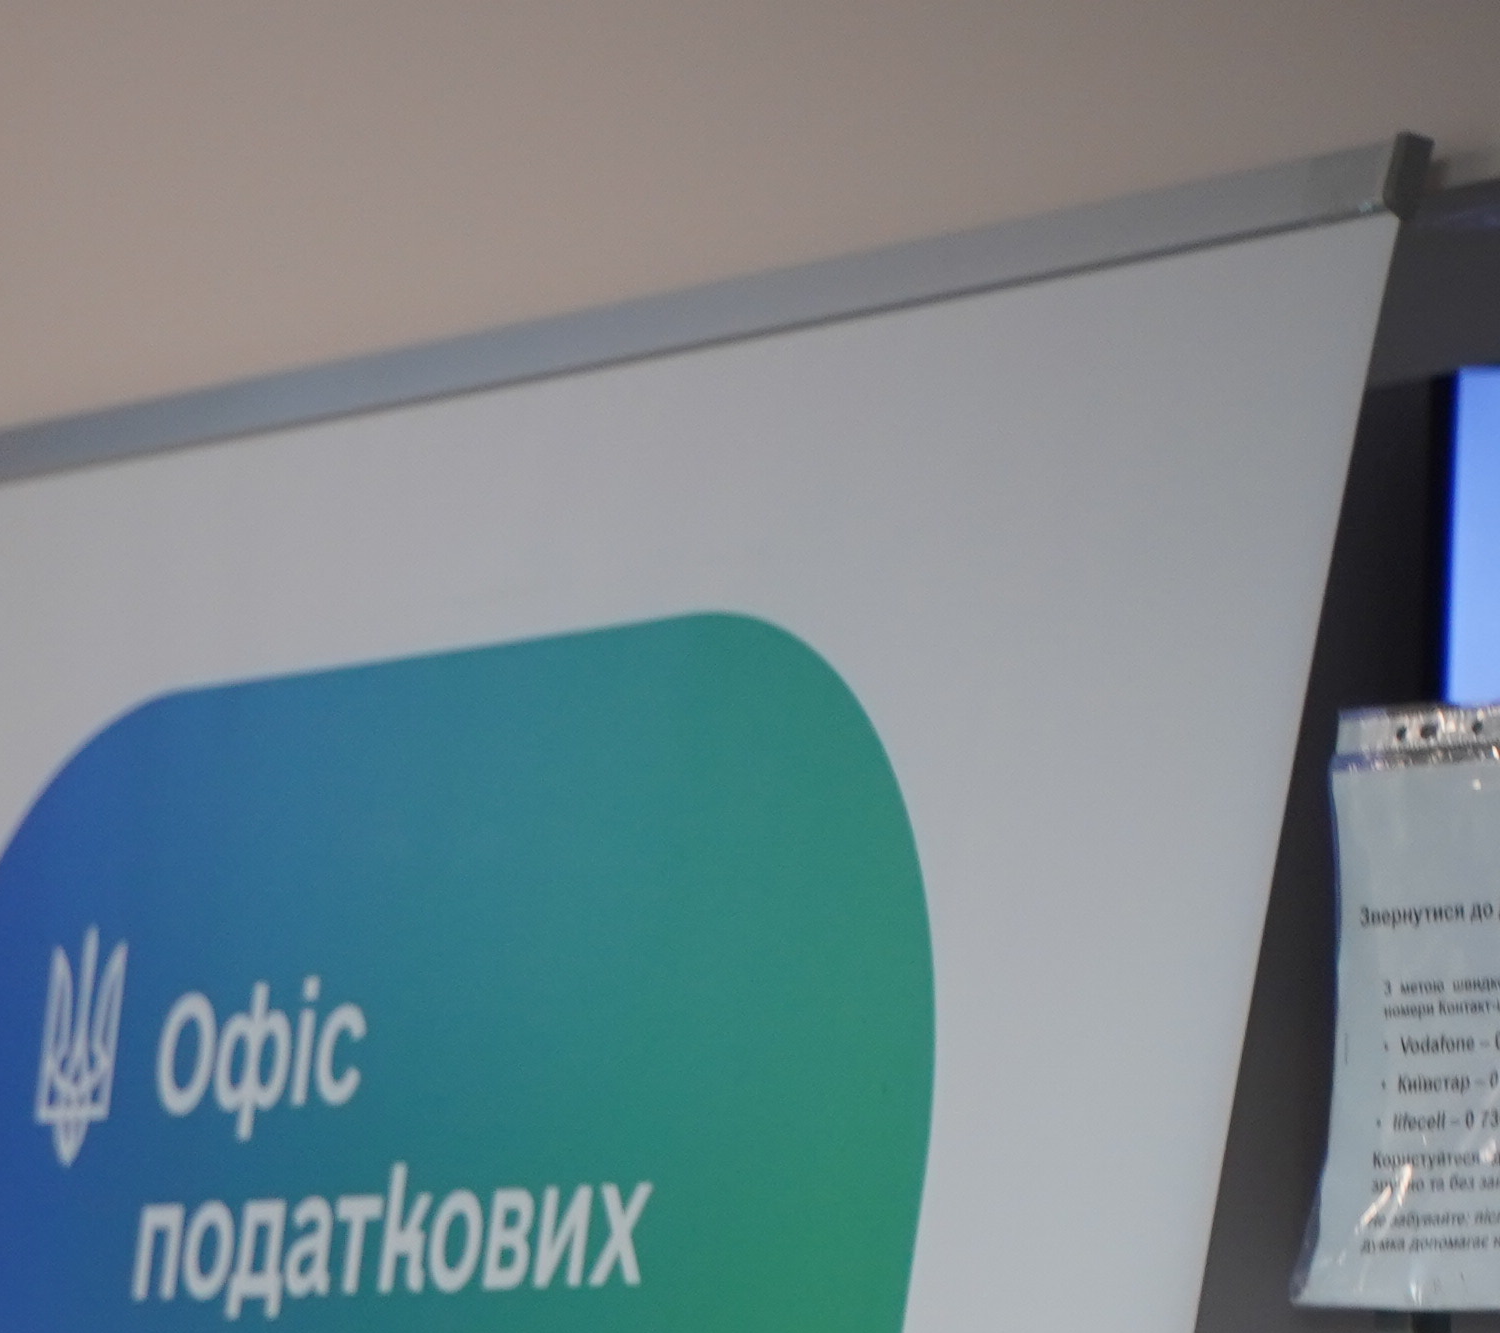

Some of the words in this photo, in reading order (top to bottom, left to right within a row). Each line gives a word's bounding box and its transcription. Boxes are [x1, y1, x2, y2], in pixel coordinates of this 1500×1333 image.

[1360, 903, 1464, 928] Звернутися
[1470, 902, 1493, 922] до
[157, 977, 367, 1142] Офіс
[1400, 1034, 1475, 1055] Vodafone
[132, 1163, 654, 1320] податкових
